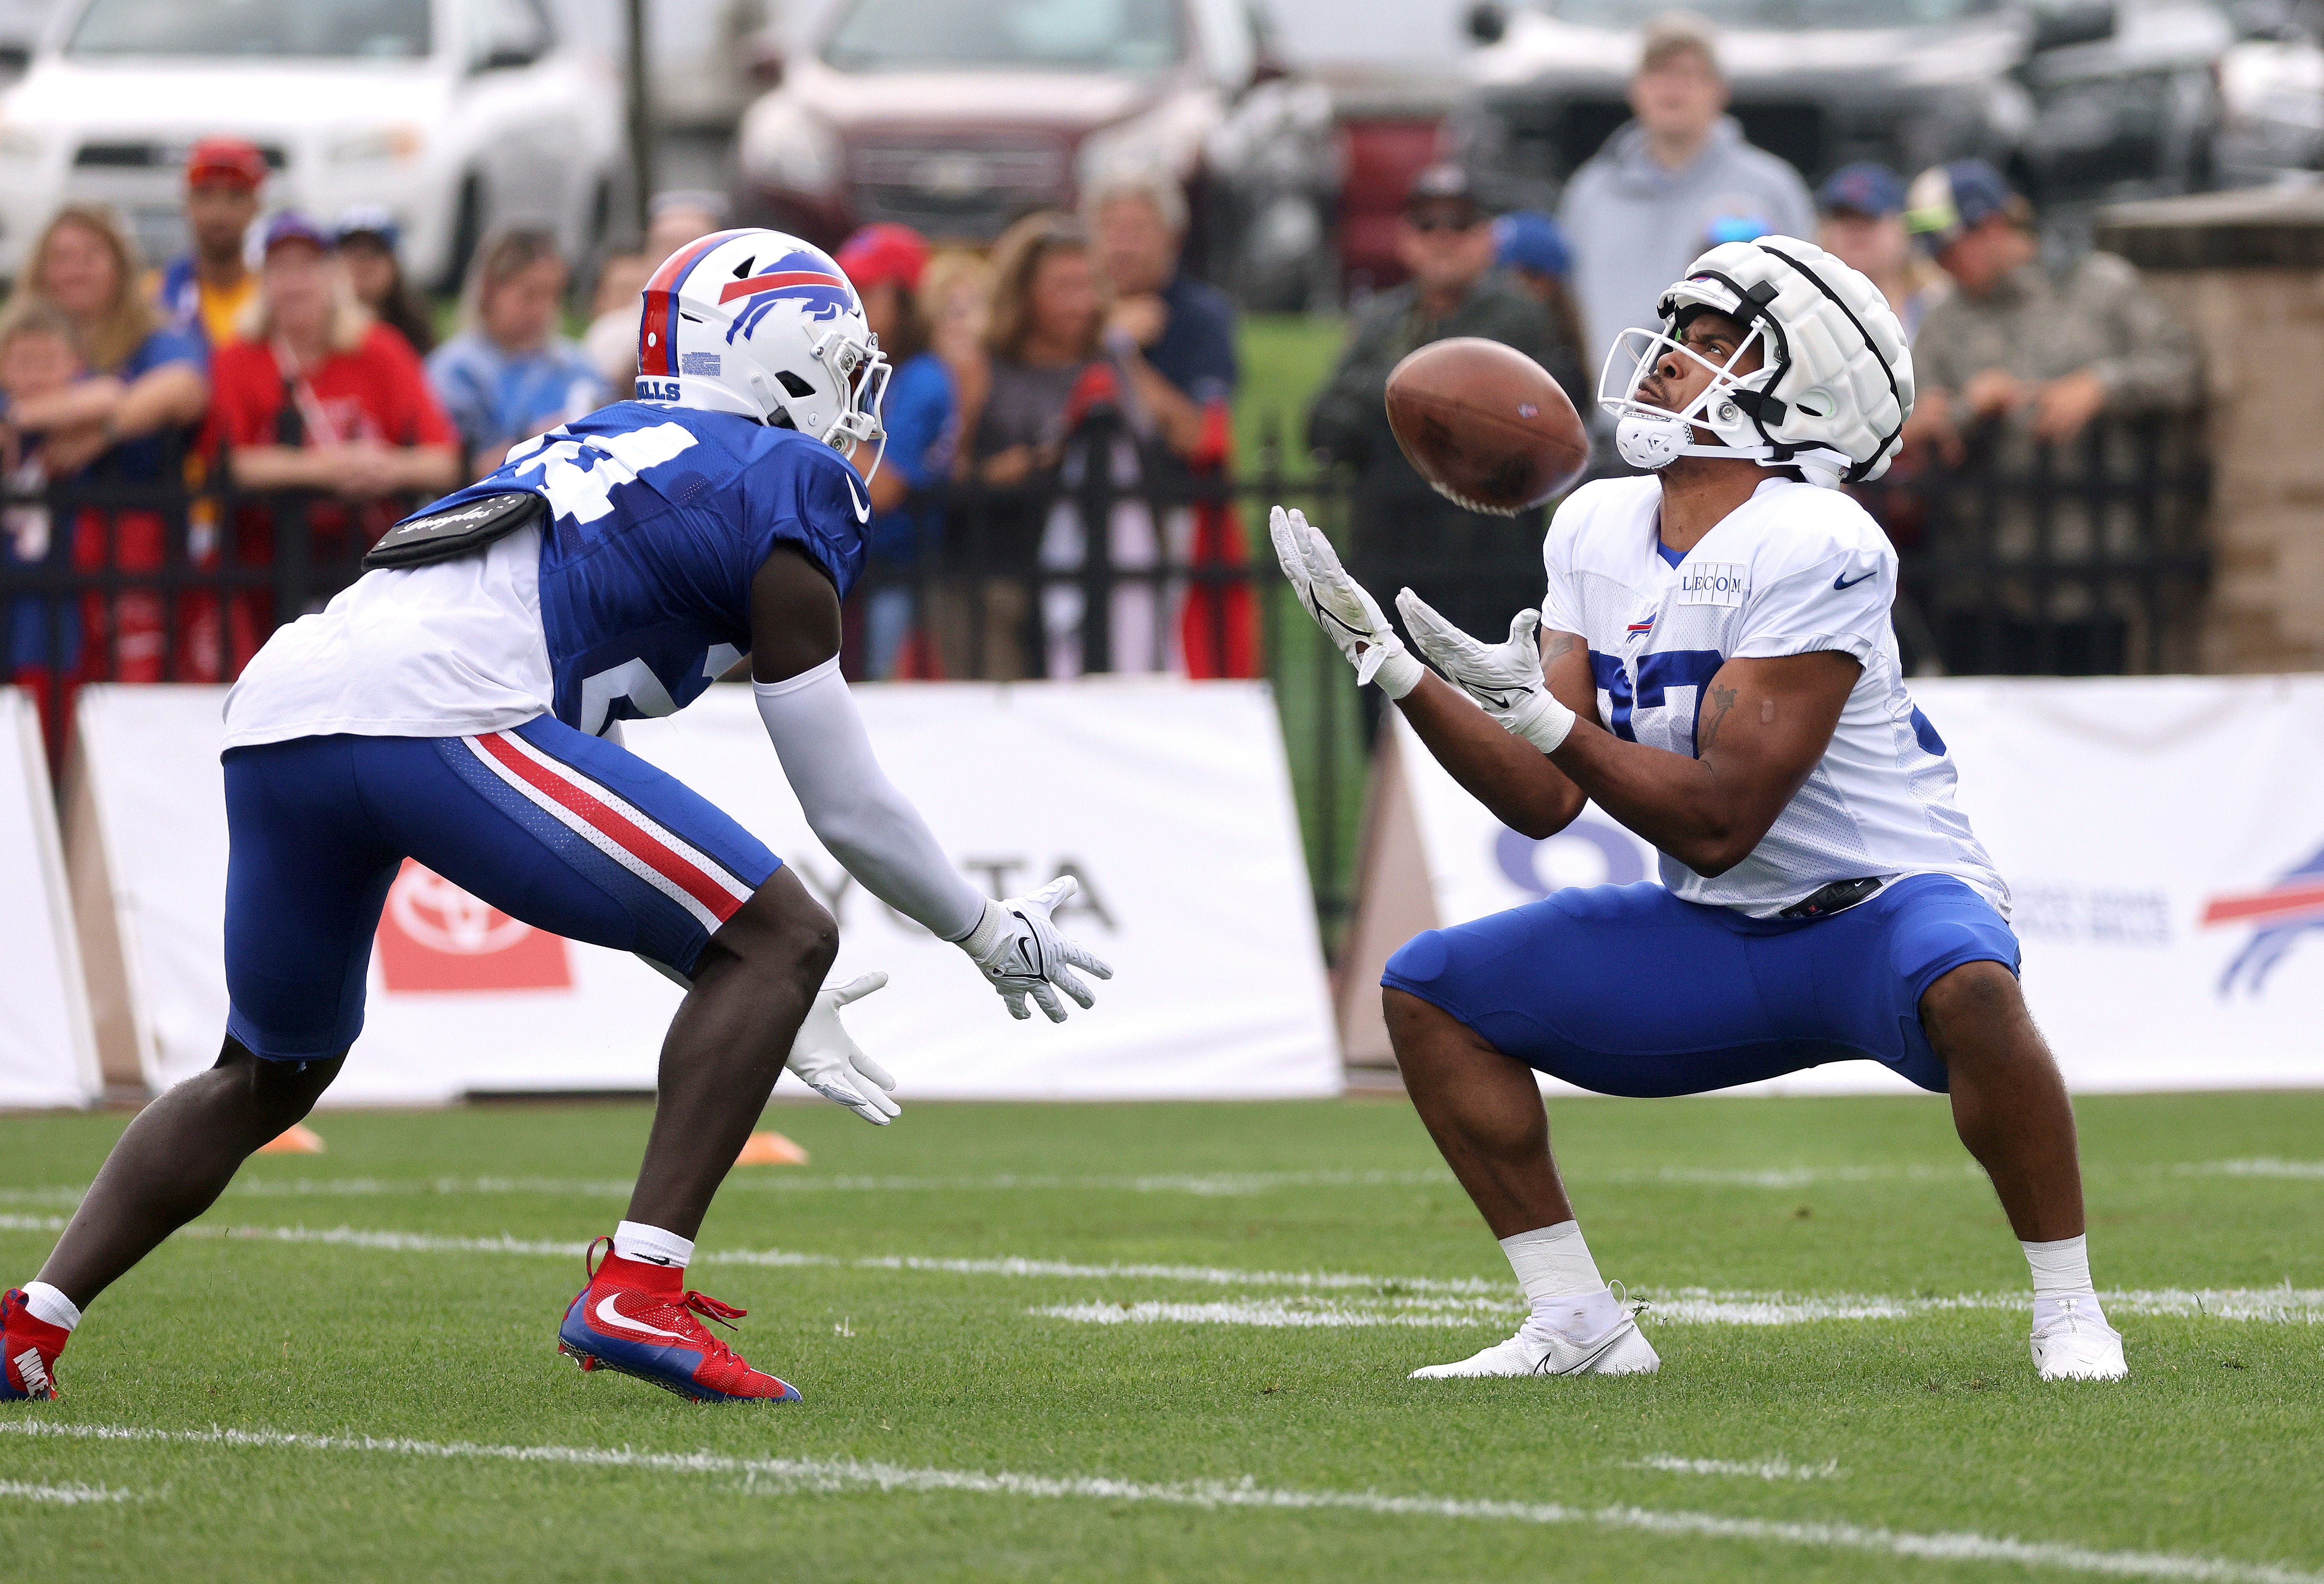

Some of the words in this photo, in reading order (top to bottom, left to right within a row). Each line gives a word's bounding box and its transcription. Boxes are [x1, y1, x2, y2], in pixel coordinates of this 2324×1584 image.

[636, 381, 681, 401] ILLS
[1682, 576, 1741, 593] LECOM
[13, 1347, 48, 1397] NIKE
